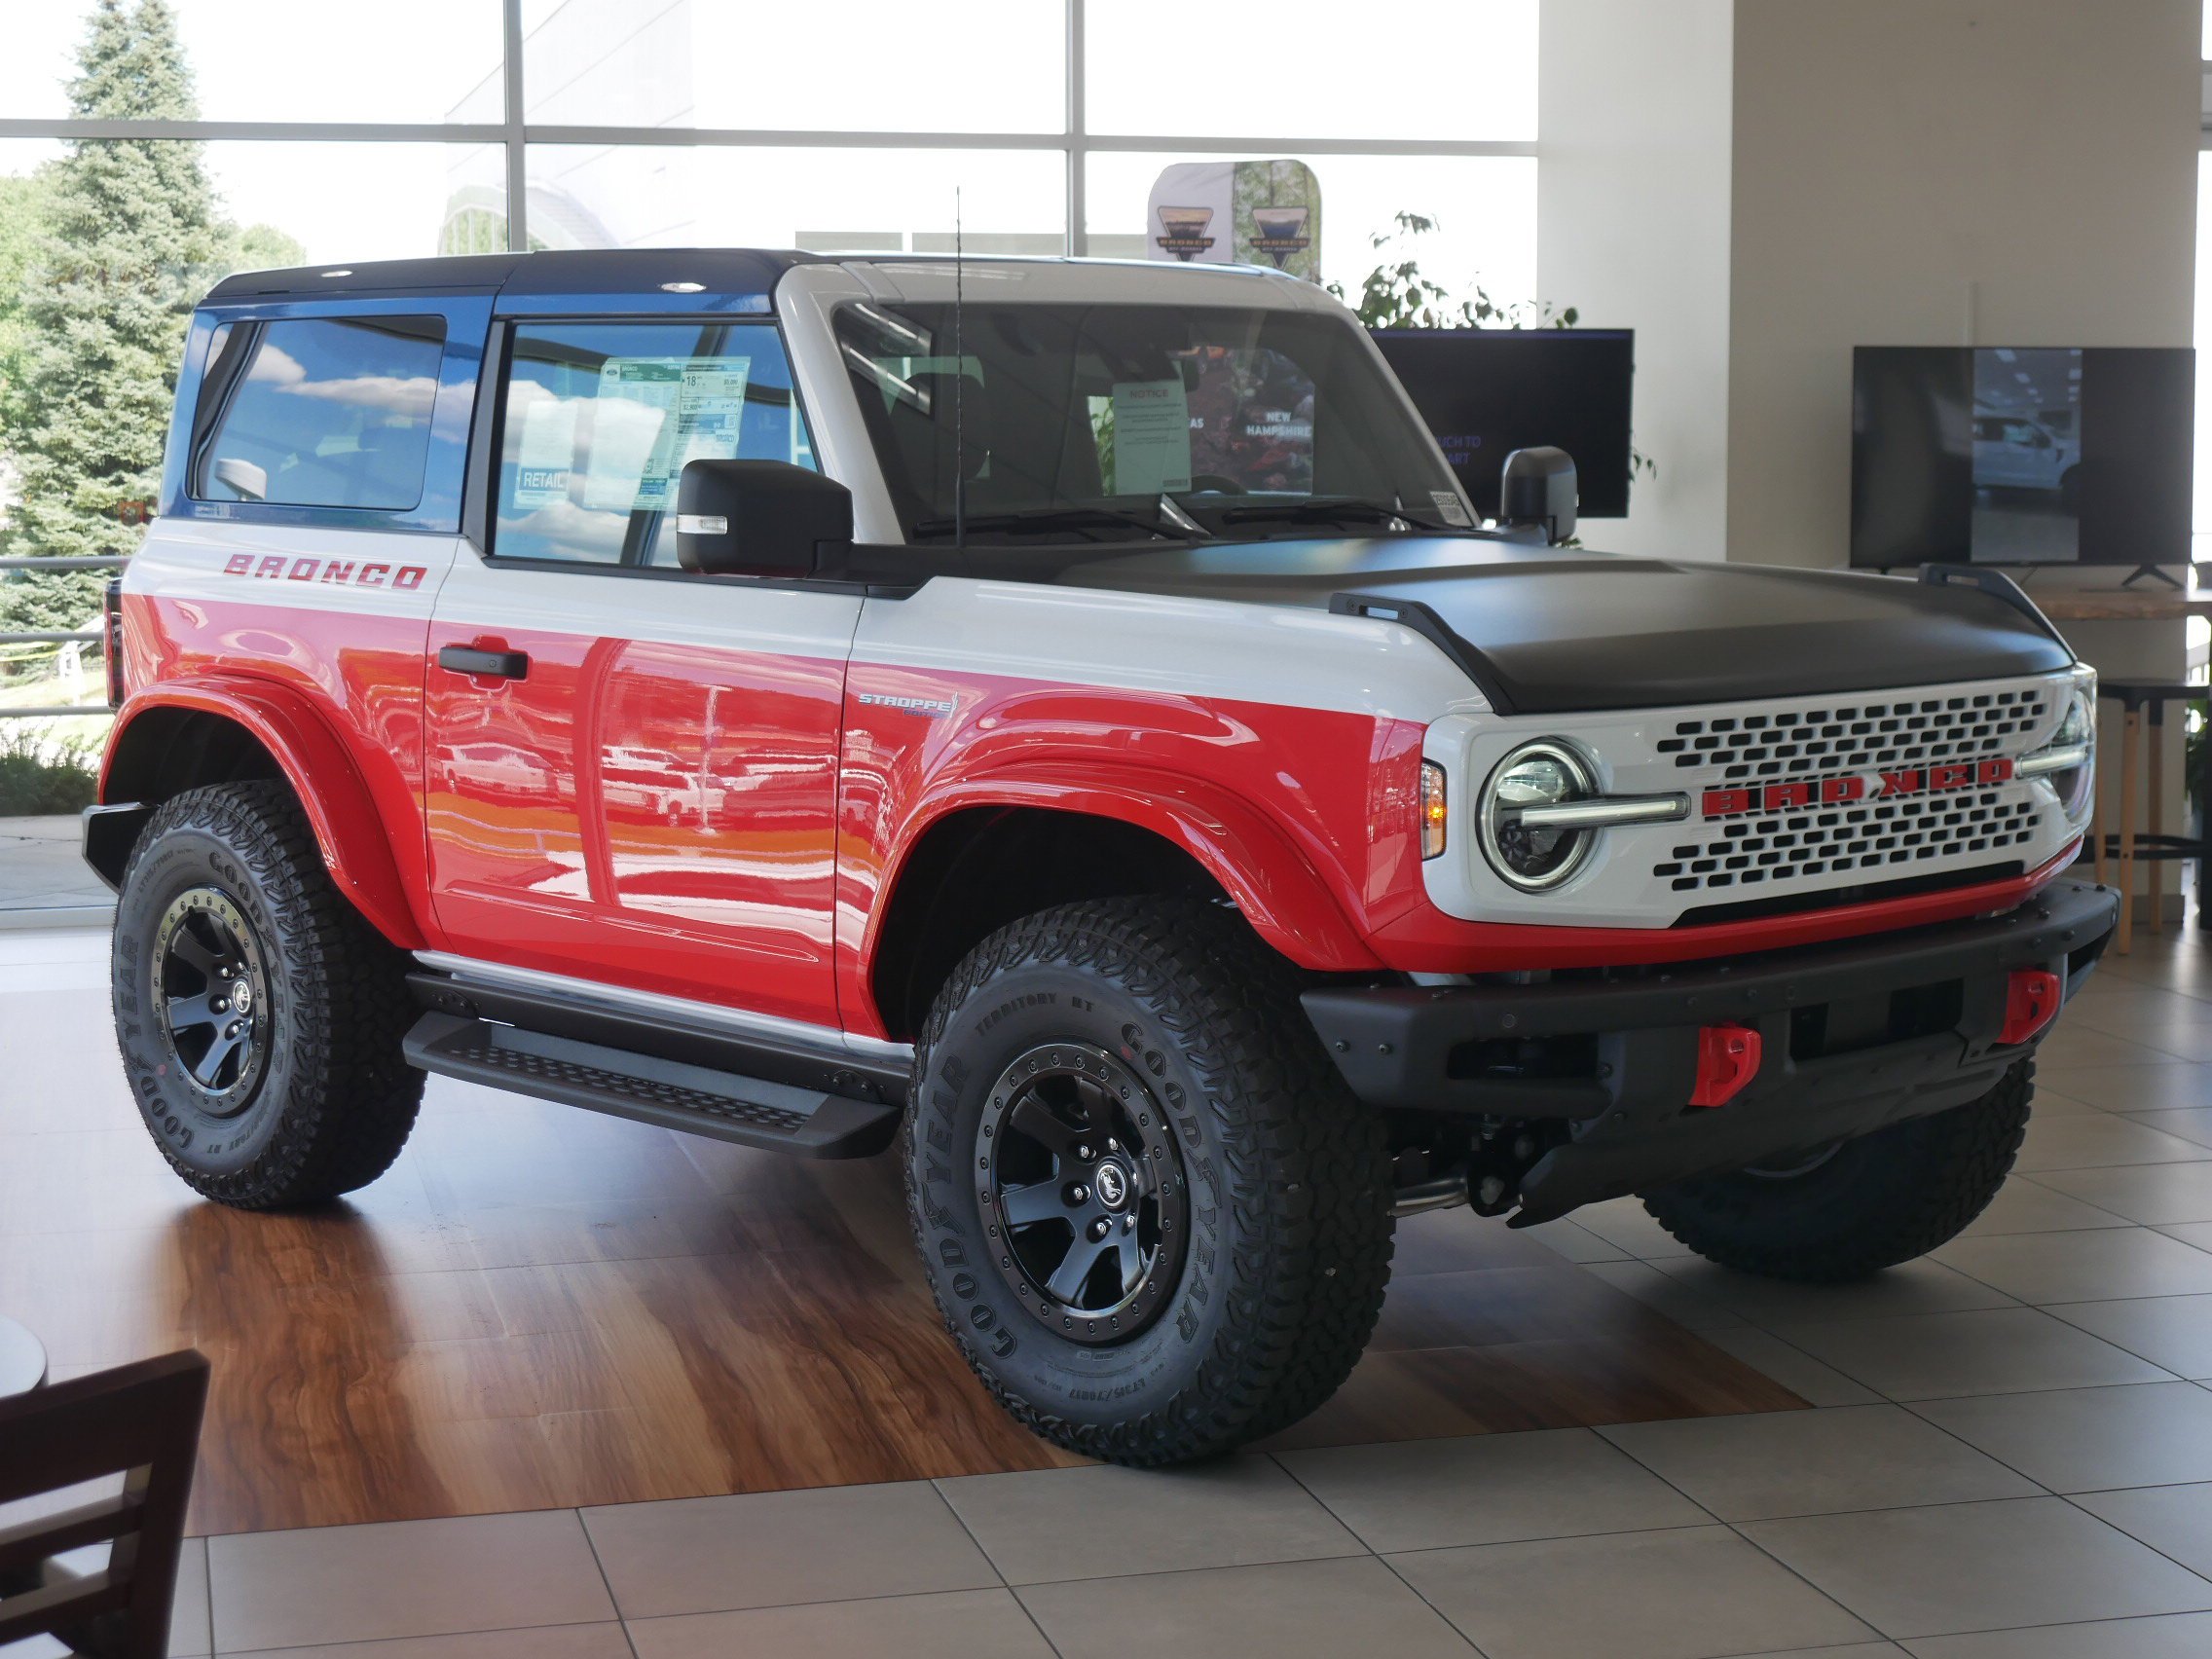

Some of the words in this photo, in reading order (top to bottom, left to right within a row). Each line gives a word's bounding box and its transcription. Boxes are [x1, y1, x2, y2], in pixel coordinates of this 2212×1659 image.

[1129, 388, 1168, 398] NOTICE
[1267, 411, 1292, 422] NEW
[1246, 424, 1312, 437] HAMPSHIRE
[1464, 435, 1481, 447] TO
[524, 471, 564, 488] RETAIL
[223, 553, 428, 591] BRONCO
[858, 693, 952, 713] STROPPE
[1701, 757, 2013, 817] BRONCO
[974, 992, 1057, 1037] TERRITORY
